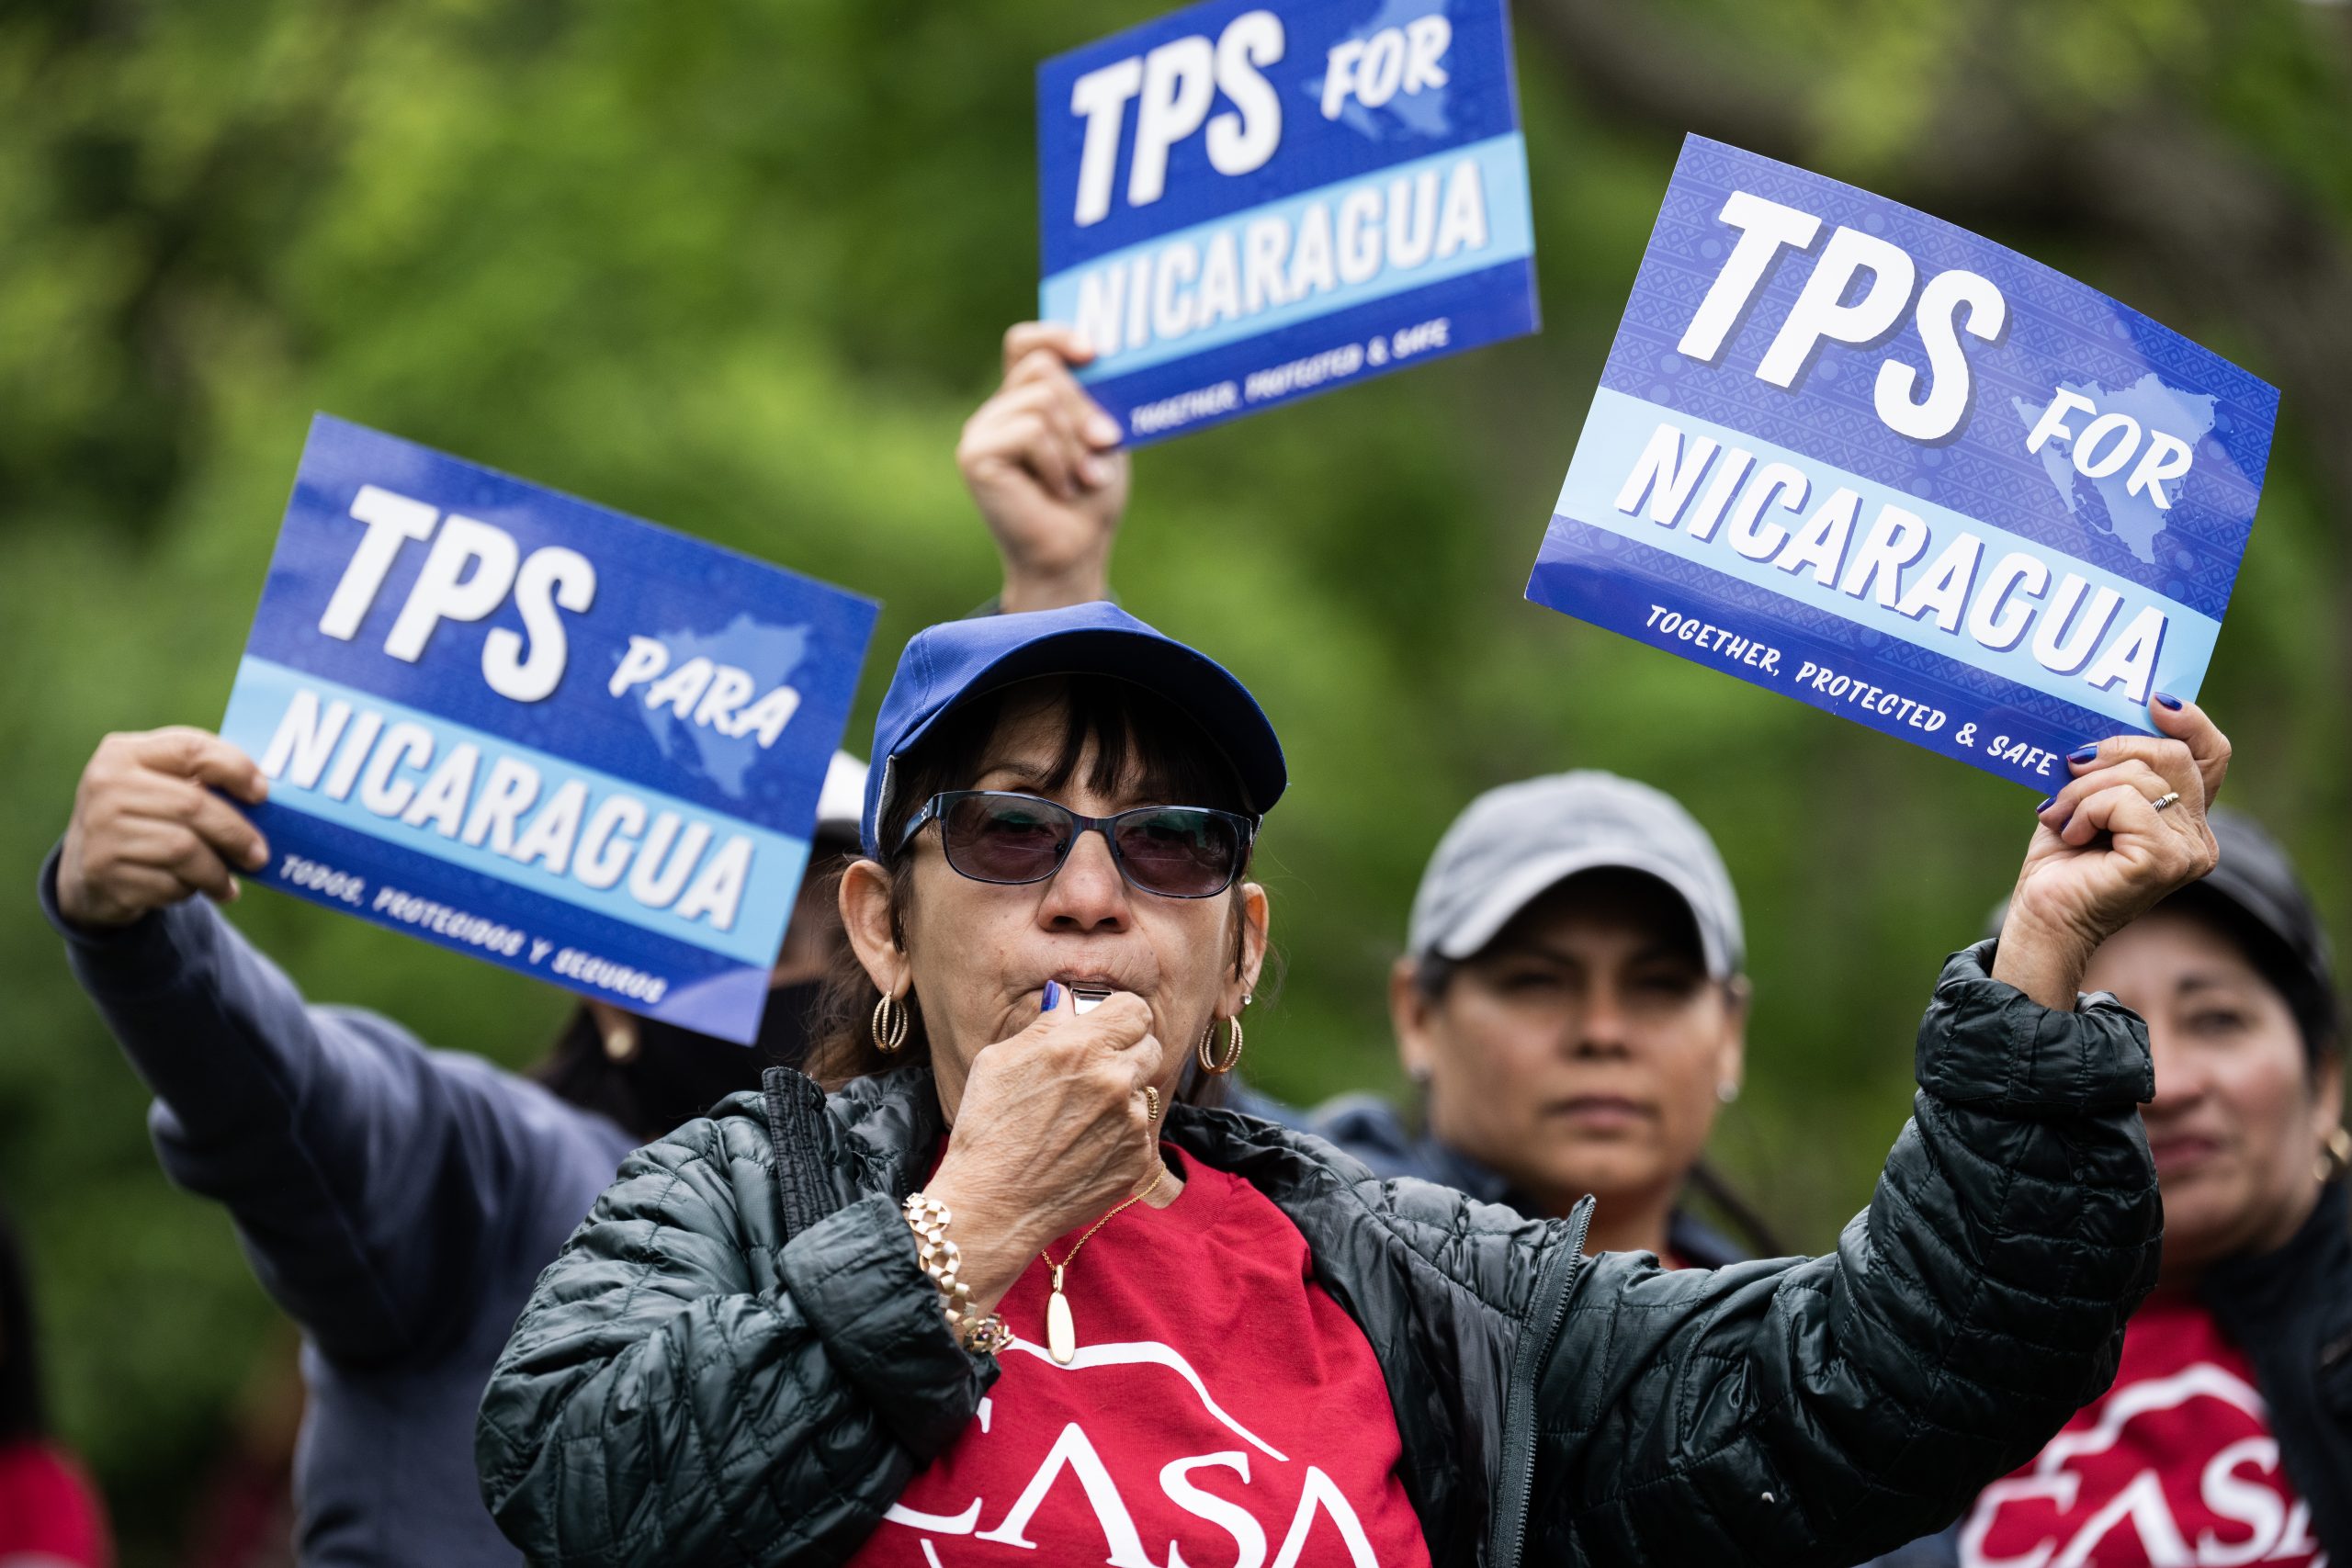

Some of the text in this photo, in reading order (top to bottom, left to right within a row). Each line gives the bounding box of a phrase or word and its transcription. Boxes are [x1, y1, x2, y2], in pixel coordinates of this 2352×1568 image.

[1070, 9, 1453, 228] TPS FOR
[1074, 158, 1489, 357] NICARAGUA
[1676, 189, 2194, 511] TPS FOR
[318, 484, 801, 749] TPS PARA
[1614, 423, 2170, 704] NICARAGUA
[1645, 604, 2058, 777] TOGETHER, PROTECTED & SAFE
[259, 689, 756, 932] NICARAGUA
[372, 886, 526, 957] PROTEGIDOS
[528, 937, 554, 965] Y
[551, 947, 669, 1005] SEGUROS
